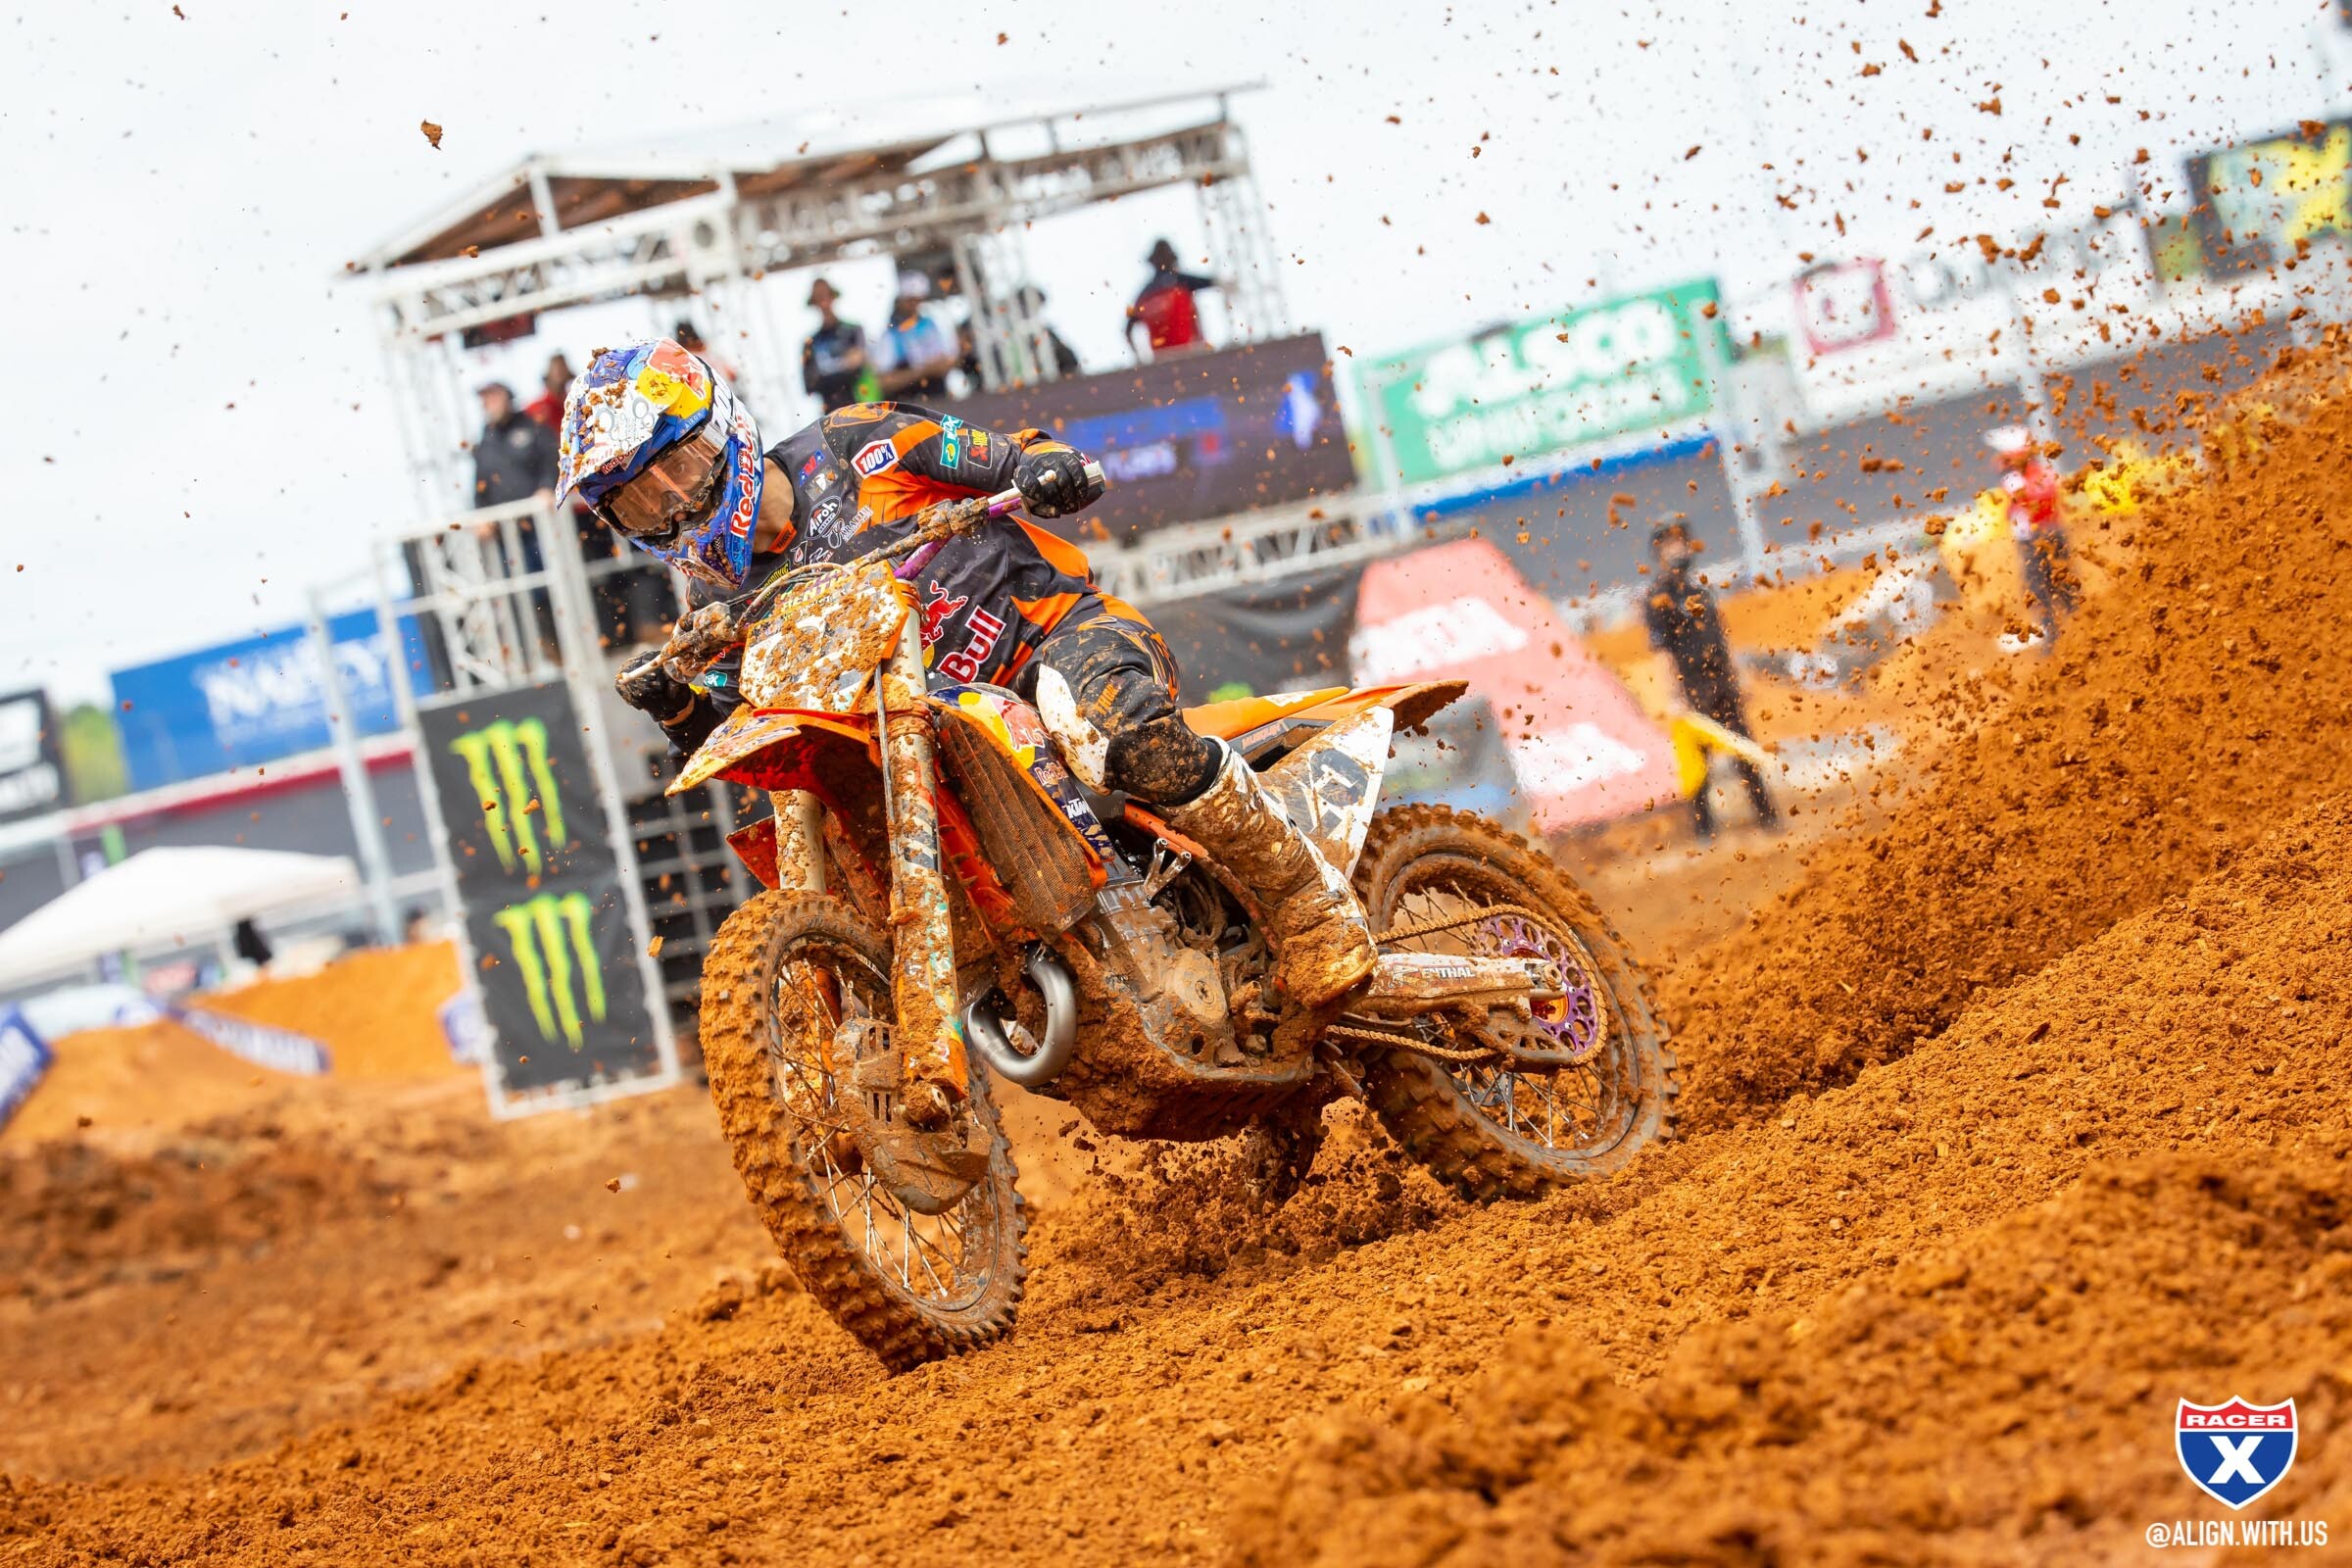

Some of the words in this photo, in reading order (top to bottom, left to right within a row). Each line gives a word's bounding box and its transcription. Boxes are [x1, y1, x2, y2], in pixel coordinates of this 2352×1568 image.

[860, 444, 894, 472] 100%
[730, 472, 755, 538] Red
[809, 502, 839, 537] Airoh
[937, 605, 1006, 684] Bull
[1066, 798, 1091, 819] KTM
